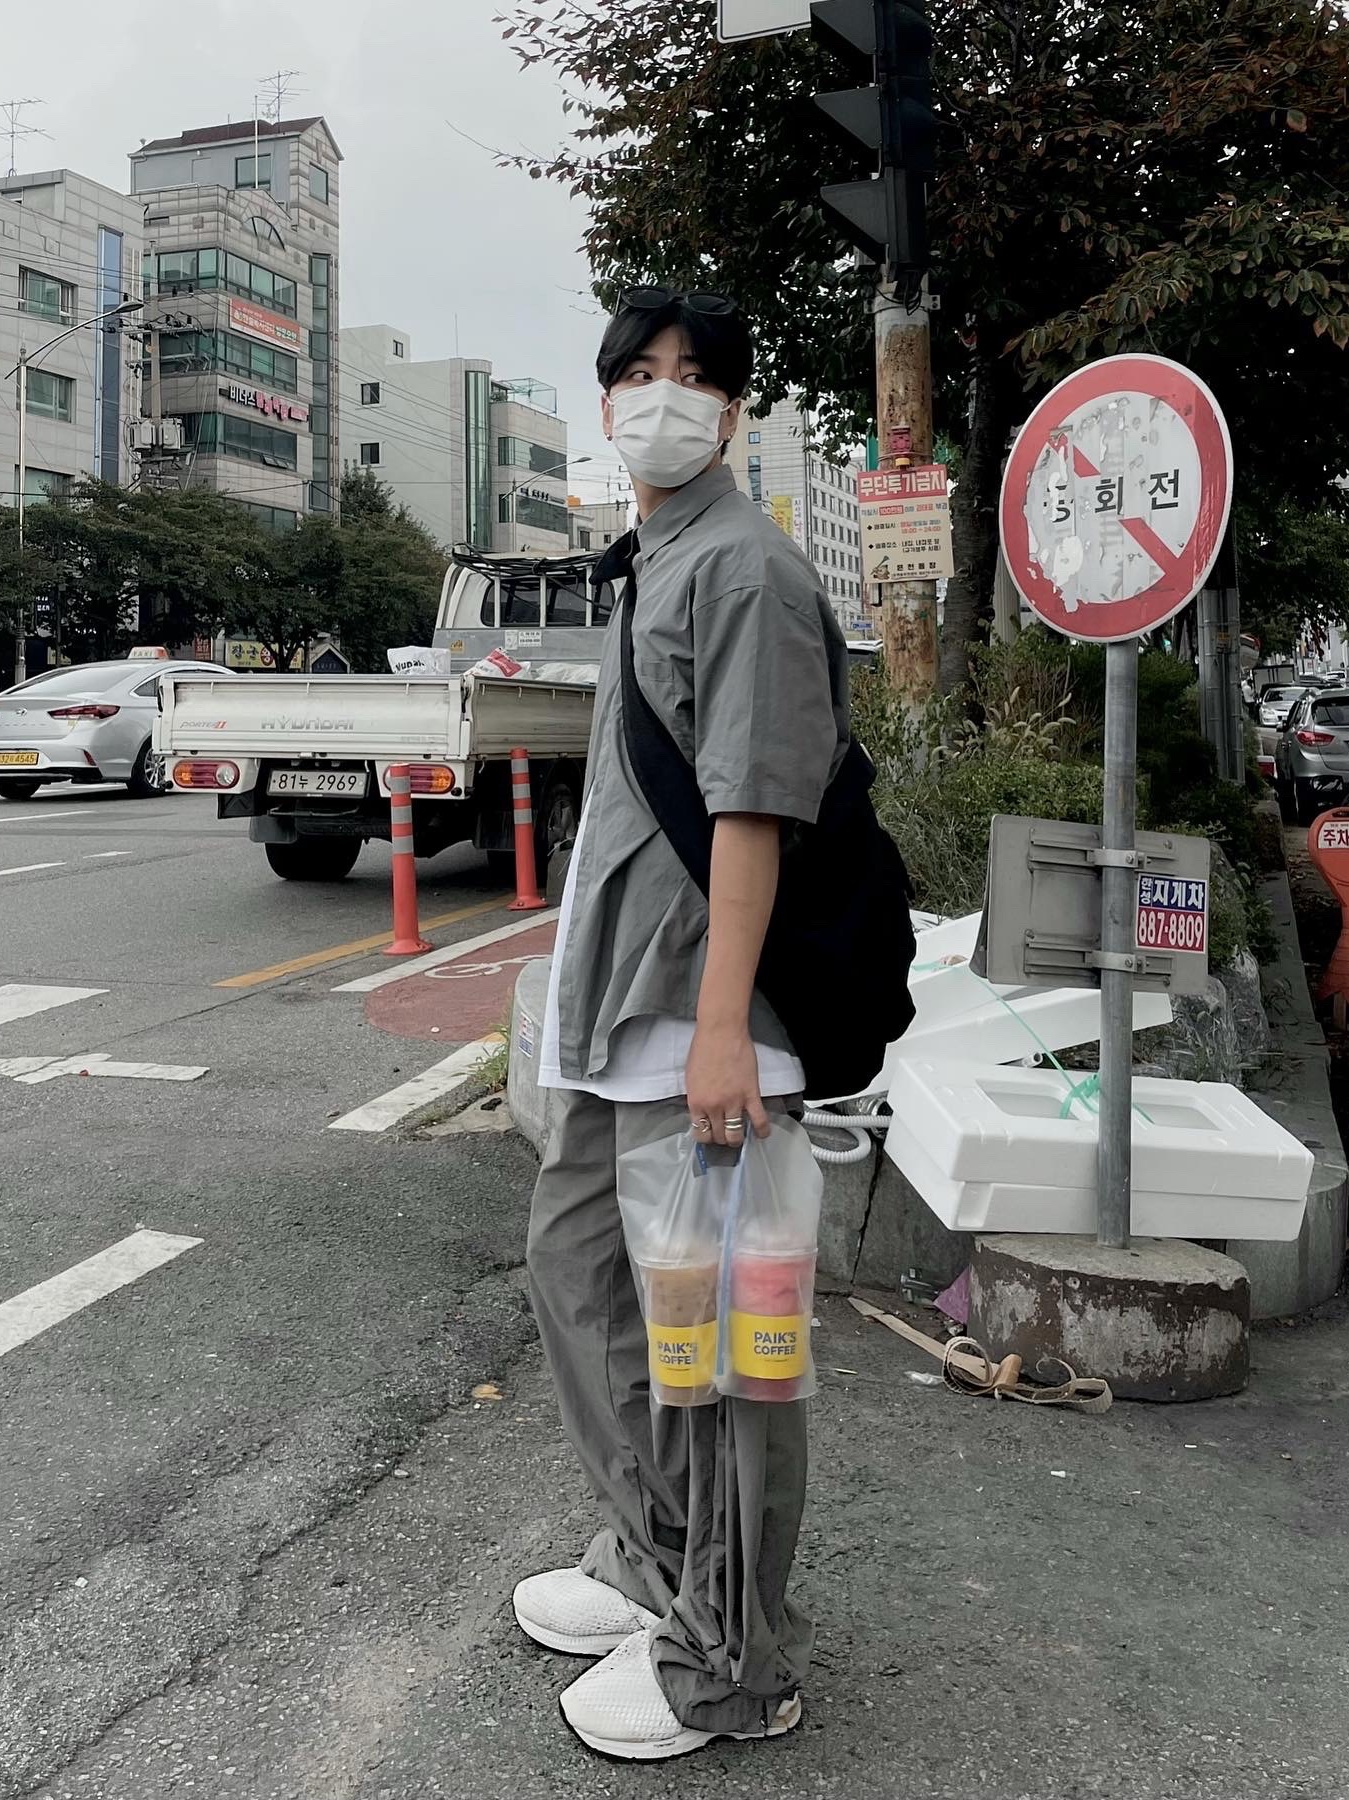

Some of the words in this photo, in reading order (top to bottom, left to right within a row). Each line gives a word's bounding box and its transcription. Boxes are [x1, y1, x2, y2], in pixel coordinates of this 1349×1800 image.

[229, 386, 256, 406] 비너스
[860, 470, 946, 497] 무단투기금지
[278, 773, 309, 790] 81누
[316, 774, 357, 791] 2969
[1152, 880, 1204, 909] 지게차
[1138, 910, 1203, 948] 887-8809
[754, 1331, 797, 1344] PAIK'S
[754, 1345, 796, 1355] COFFEE
